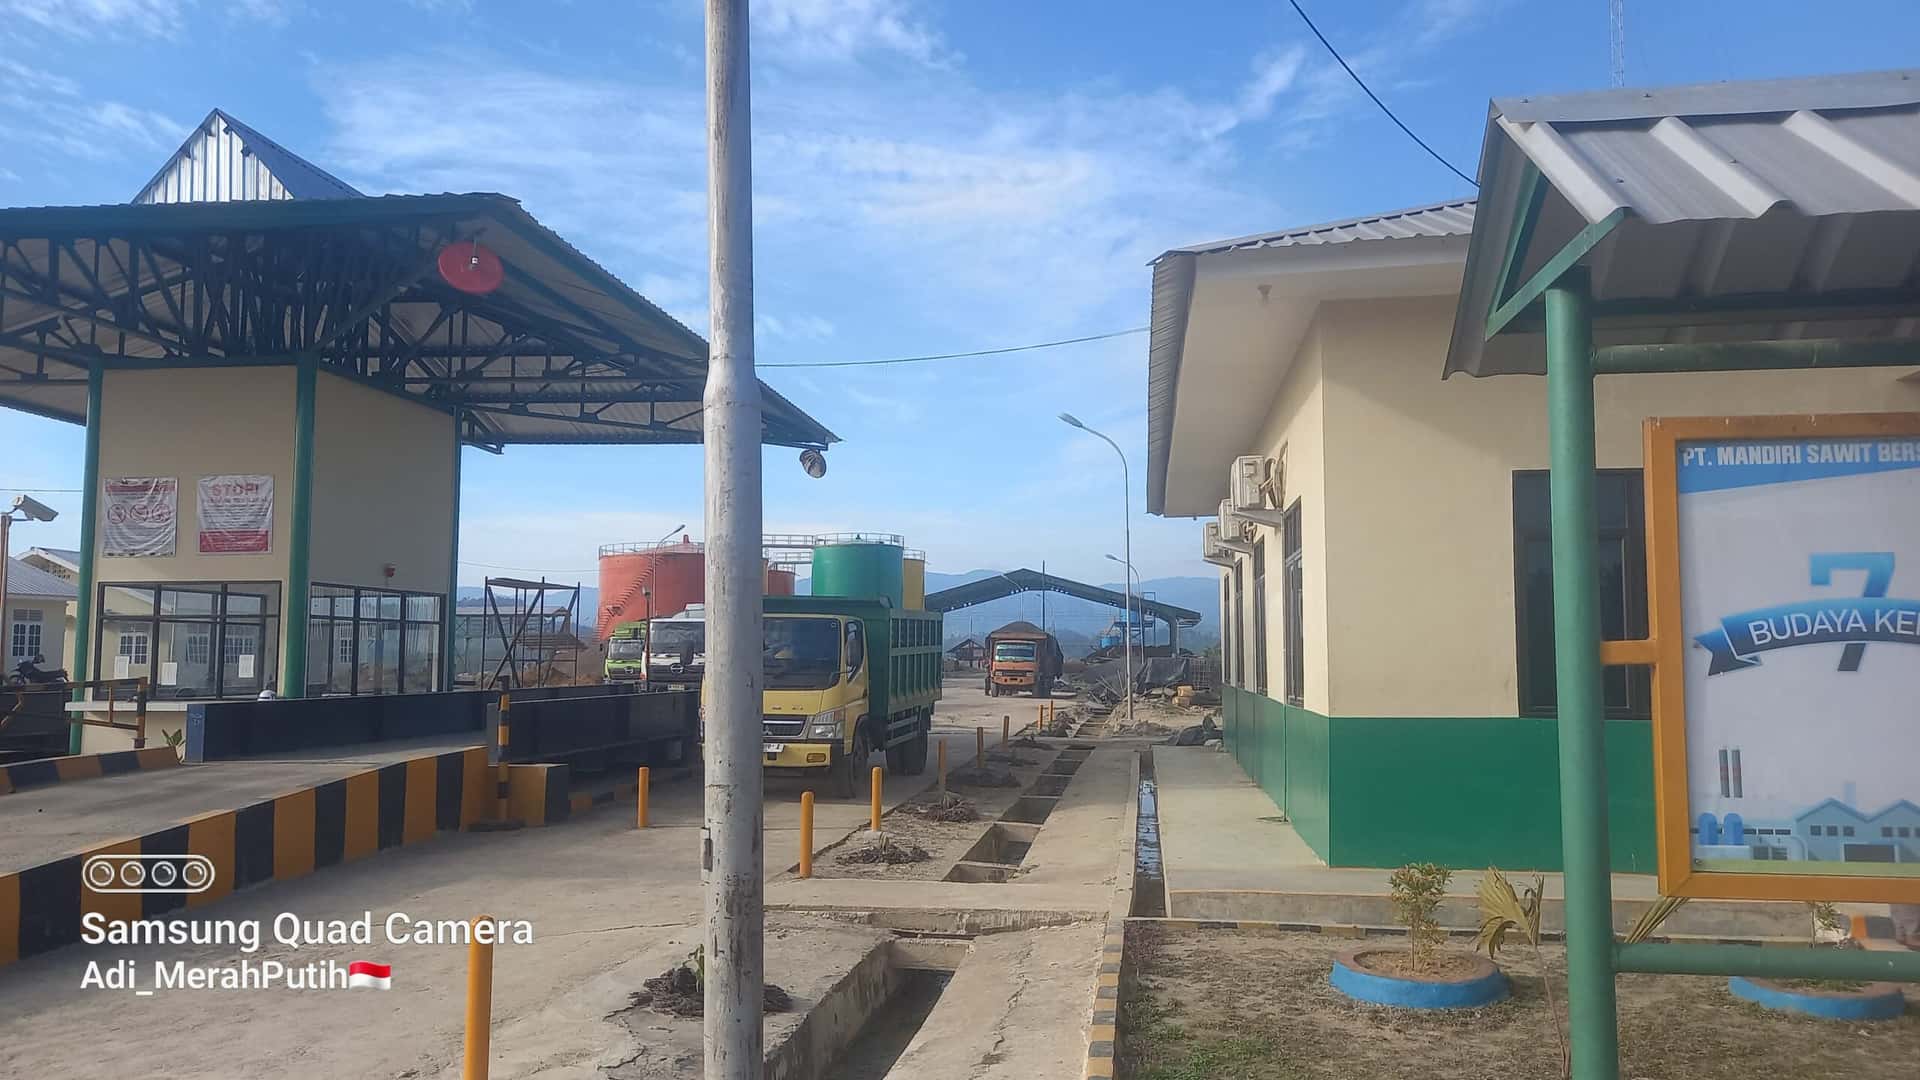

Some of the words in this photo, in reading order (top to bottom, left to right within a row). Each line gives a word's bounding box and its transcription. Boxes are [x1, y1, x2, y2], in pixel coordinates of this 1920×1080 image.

[1683, 448, 1713, 466] PT.
[1717, 445, 1801, 466] MANDIRI
[1807, 443, 1872, 463] SAWIT
[1748, 608, 1867, 646] BUDAYA
[1874, 608, 1920, 636] KE
[1809, 552, 1896, 672] 7
